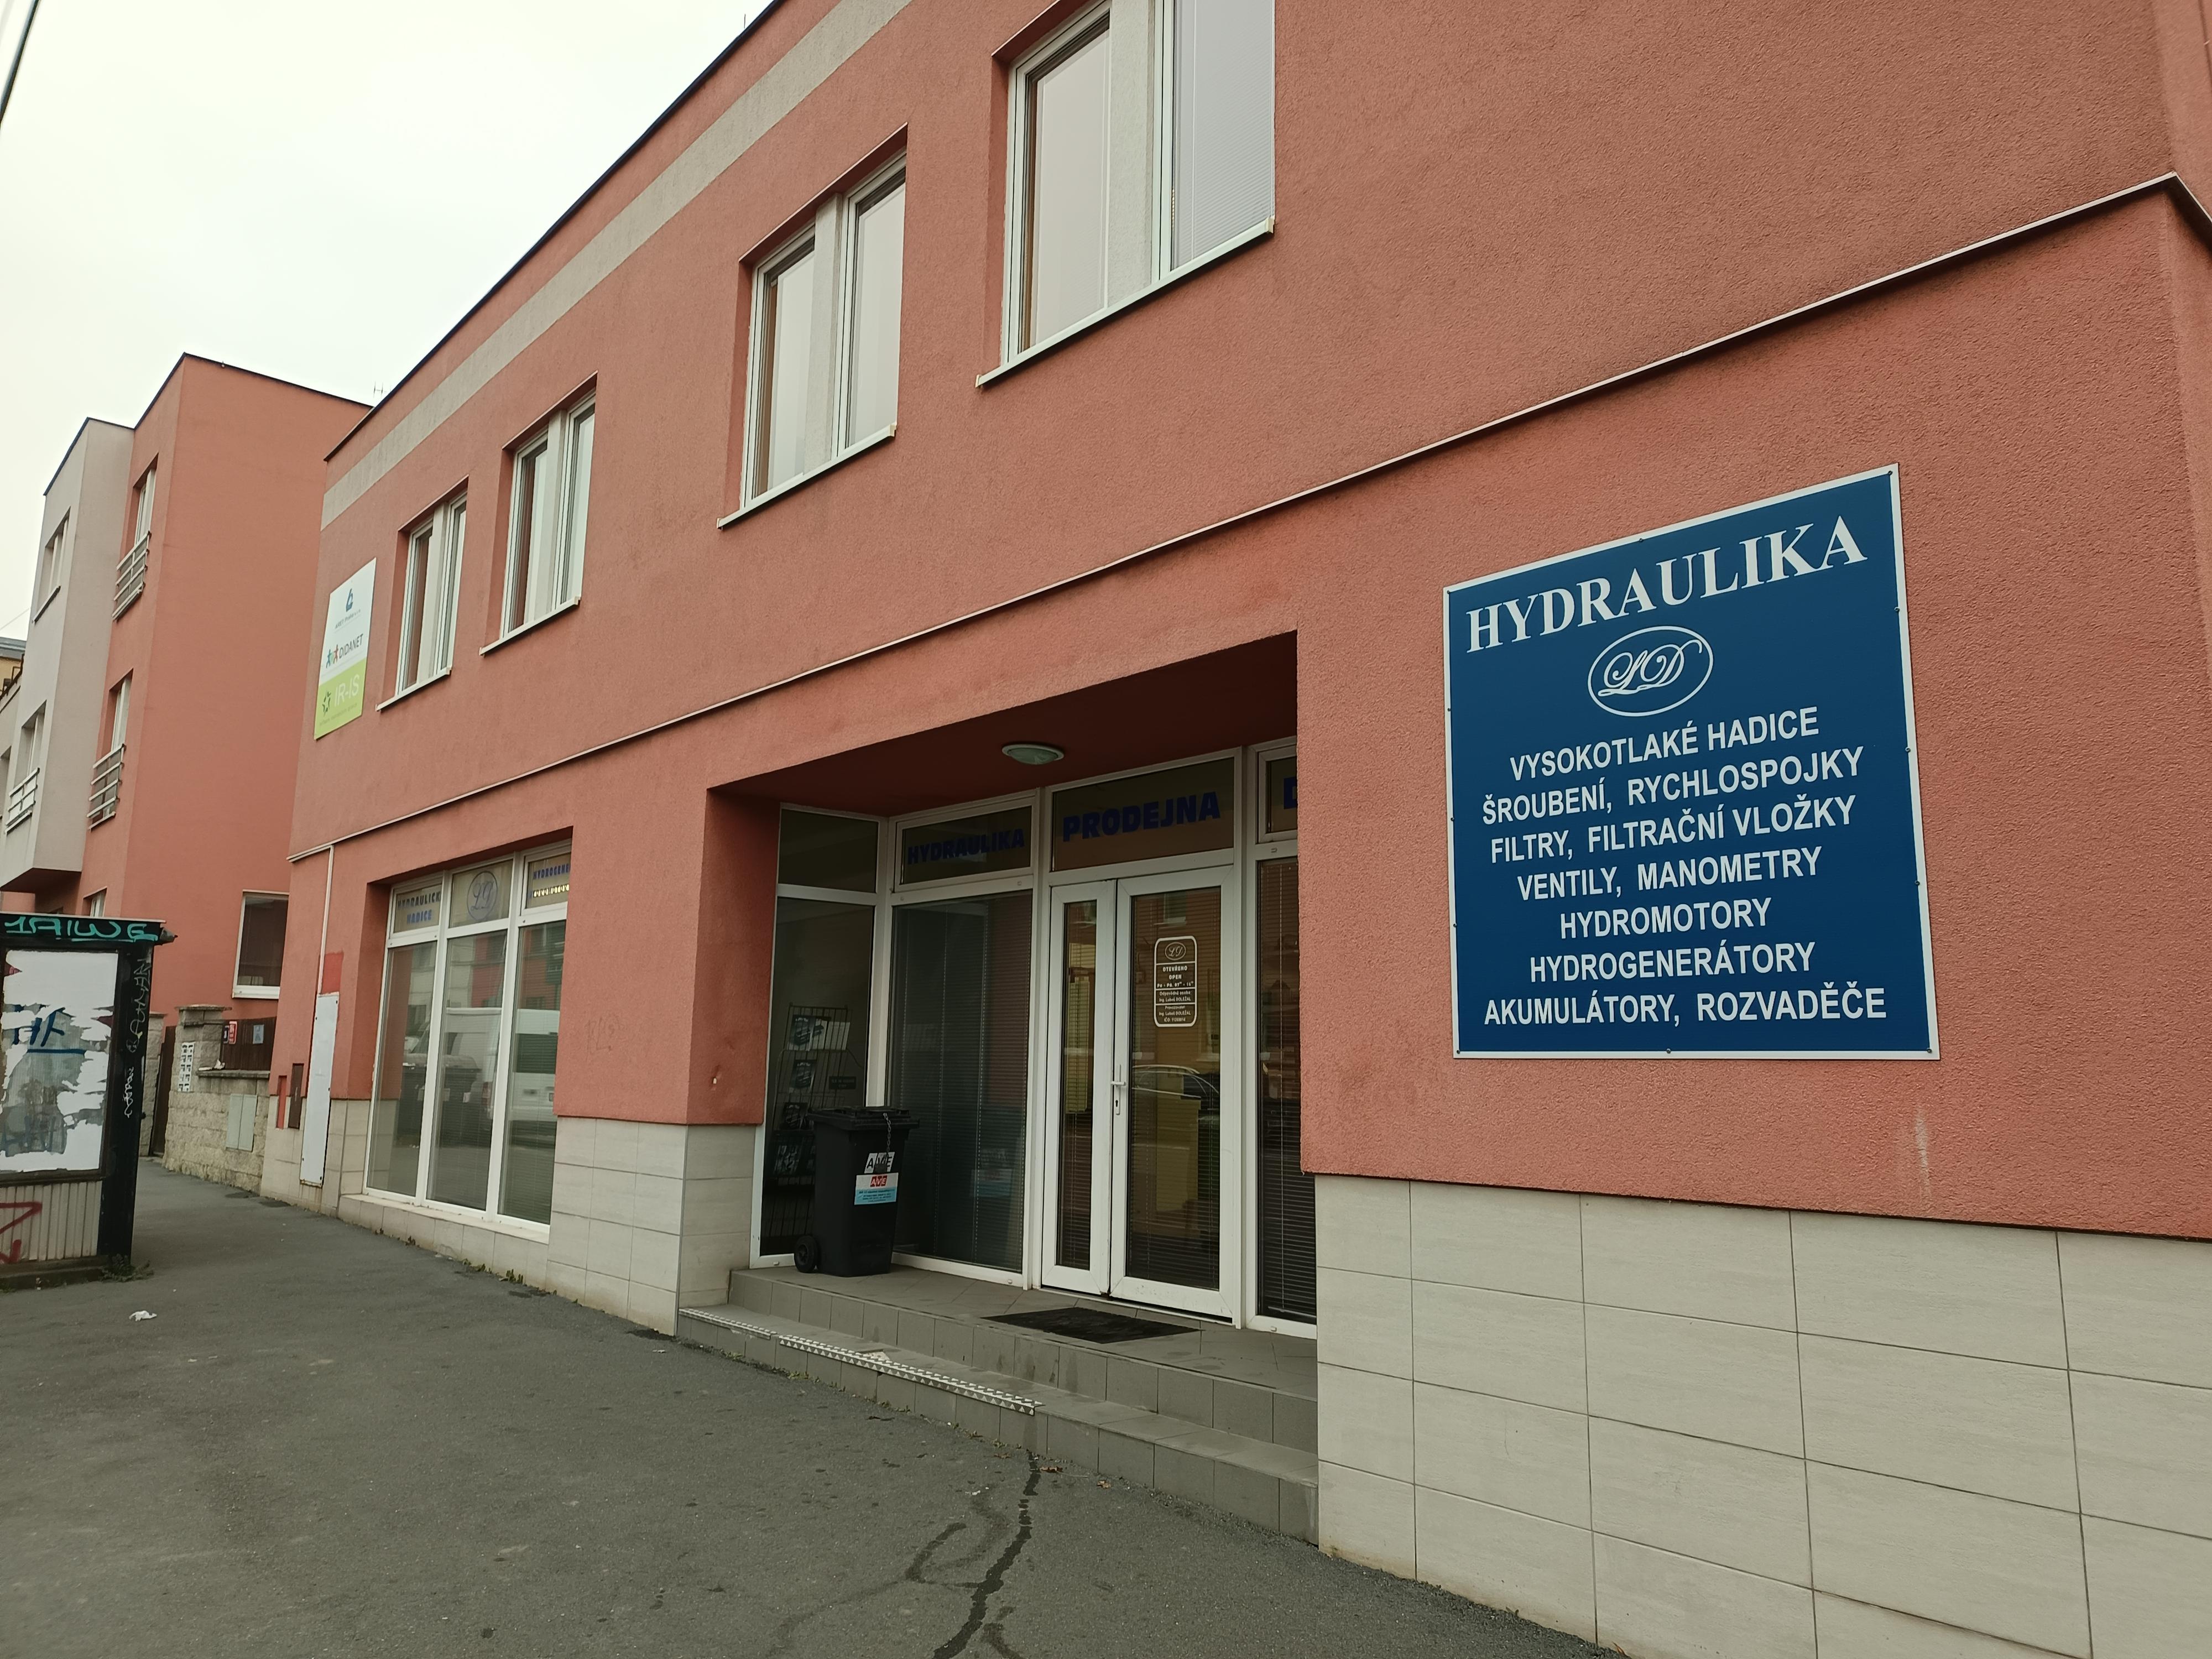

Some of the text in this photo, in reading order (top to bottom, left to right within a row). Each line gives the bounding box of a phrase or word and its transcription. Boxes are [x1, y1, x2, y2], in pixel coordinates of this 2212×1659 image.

[1465, 515, 1868, 653] HYDRAULIKA
[339, 633, 363, 659] DIDANET
[334, 674, 359, 707] IR-IS
[1510, 707, 1819, 781] VYSOKOTLAKÉ HADICE
[1482, 746, 1864, 825] ŠROUBENÍ, RYCHLOSPOJKY
[1062, 791, 1220, 842] PRODEJNA
[1491, 793, 1856, 864] FILTRY, FILTRAČNÍ VLOŽKY
[907, 828, 1025, 865] HYDRAULIKA
[1518, 847, 1823, 901] VENTILY, MANOMETRY
[406, 909, 432, 925] HADICE
[1561, 897, 1771, 939] HYDROMOTORY
[1530, 940, 1815, 983] HYDROGENERÁTORY
[1484, 981, 1886, 1027] AKUMULÁTORY, ROZVADĚČE
[871, 1177, 886, 1186] AVE
